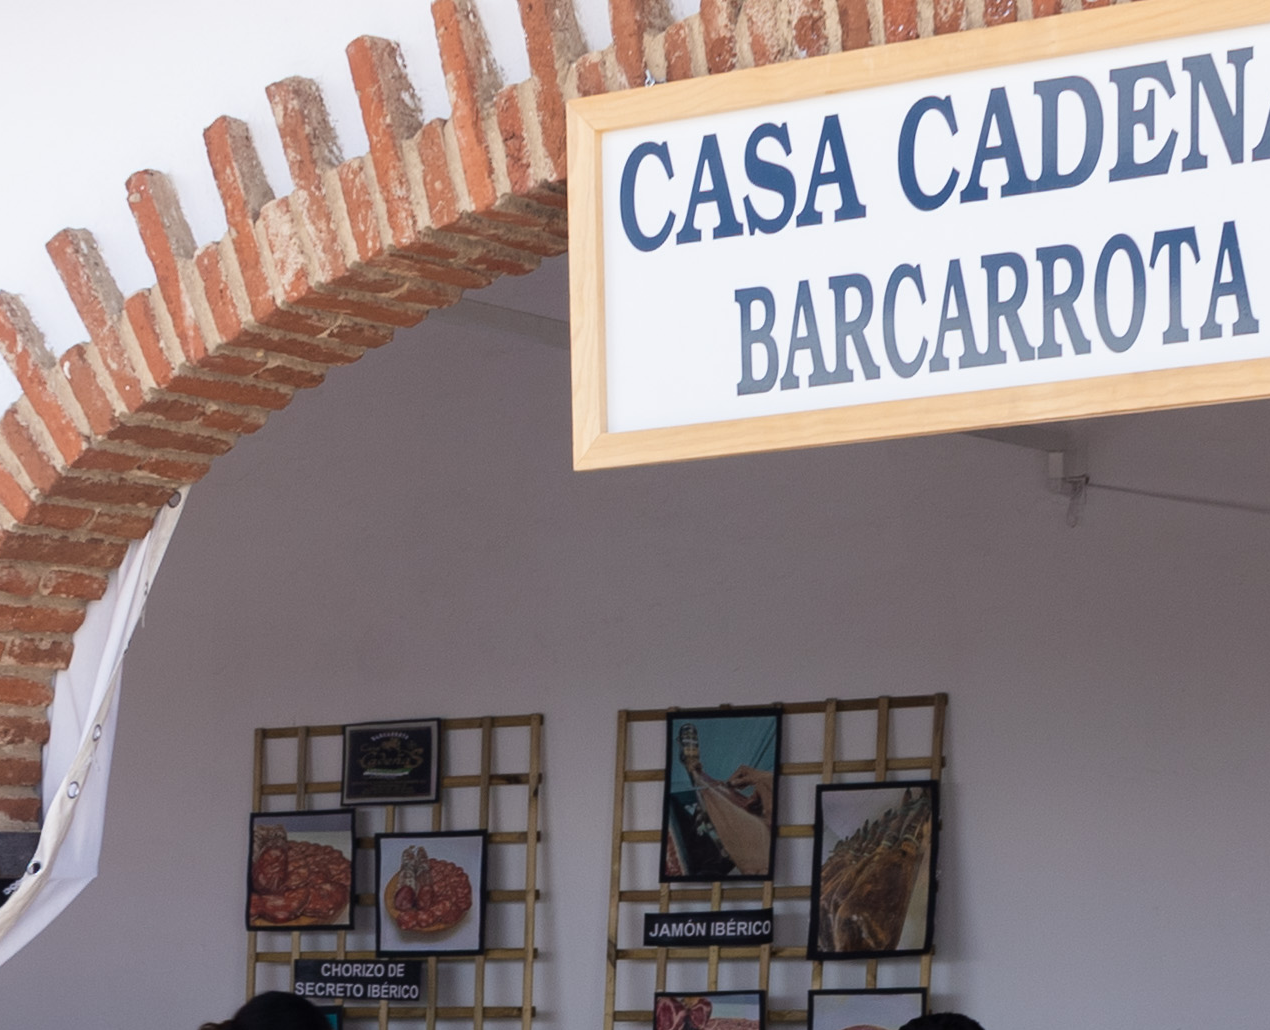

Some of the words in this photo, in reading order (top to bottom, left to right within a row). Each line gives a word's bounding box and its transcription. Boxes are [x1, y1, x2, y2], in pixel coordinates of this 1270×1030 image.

[619, 113, 866, 252] CASA
[734, 220, 1259, 397] BARCARROTA
[649, 919, 706, 938] JAMÓN
[710, 917, 772, 936] IBÉRICO
[320, 963, 385, 977] CHORIZO
[387, 963, 405, 977] DE
[294, 982, 364, 998] SECRETO
[367, 981, 419, 999] IBÉRICO
